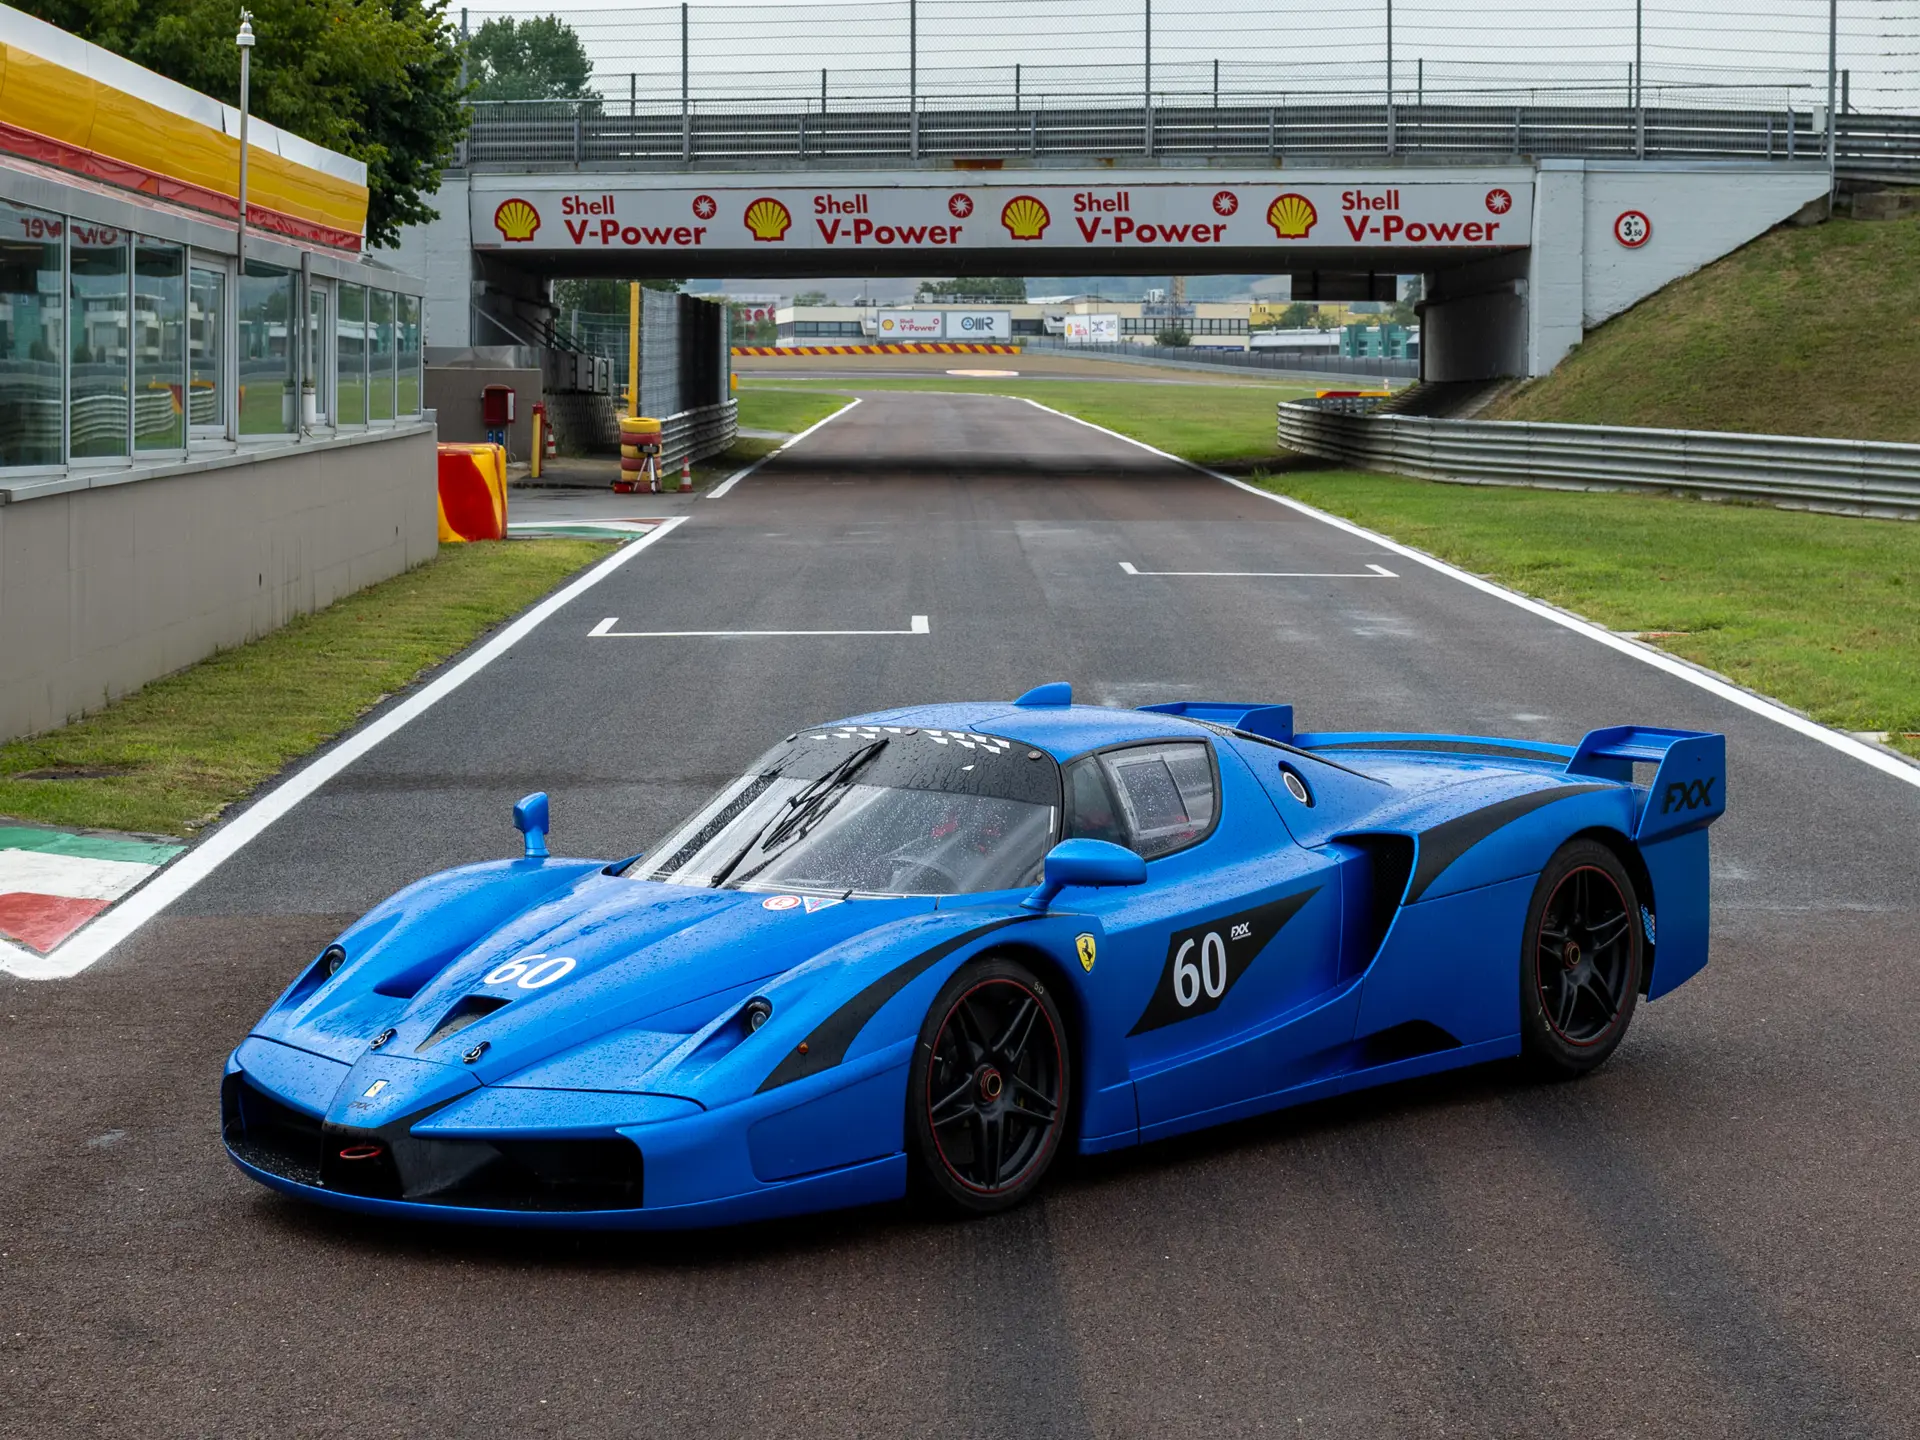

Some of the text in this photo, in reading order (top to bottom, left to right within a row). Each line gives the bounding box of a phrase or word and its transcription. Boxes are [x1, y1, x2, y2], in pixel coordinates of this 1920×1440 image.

[562, 196, 615, 214] Shell
[814, 194, 868, 213] Shell
[1073, 192, 1129, 212] Shell
[1342, 190, 1399, 210] Shell
[566, 219, 706, 245] V-Power
[817, 218, 961, 244] V-Power
[1076, 217, 1228, 243] V-Power
[1344, 214, 1500, 242] V-Power
[899, 324, 937, 332] V-Power
[1660, 777, 1716, 815] FXX
[1231, 921, 1250, 938] FXX
[483, 953, 576, 989] 60
[1173, 931, 1227, 1008] 60
